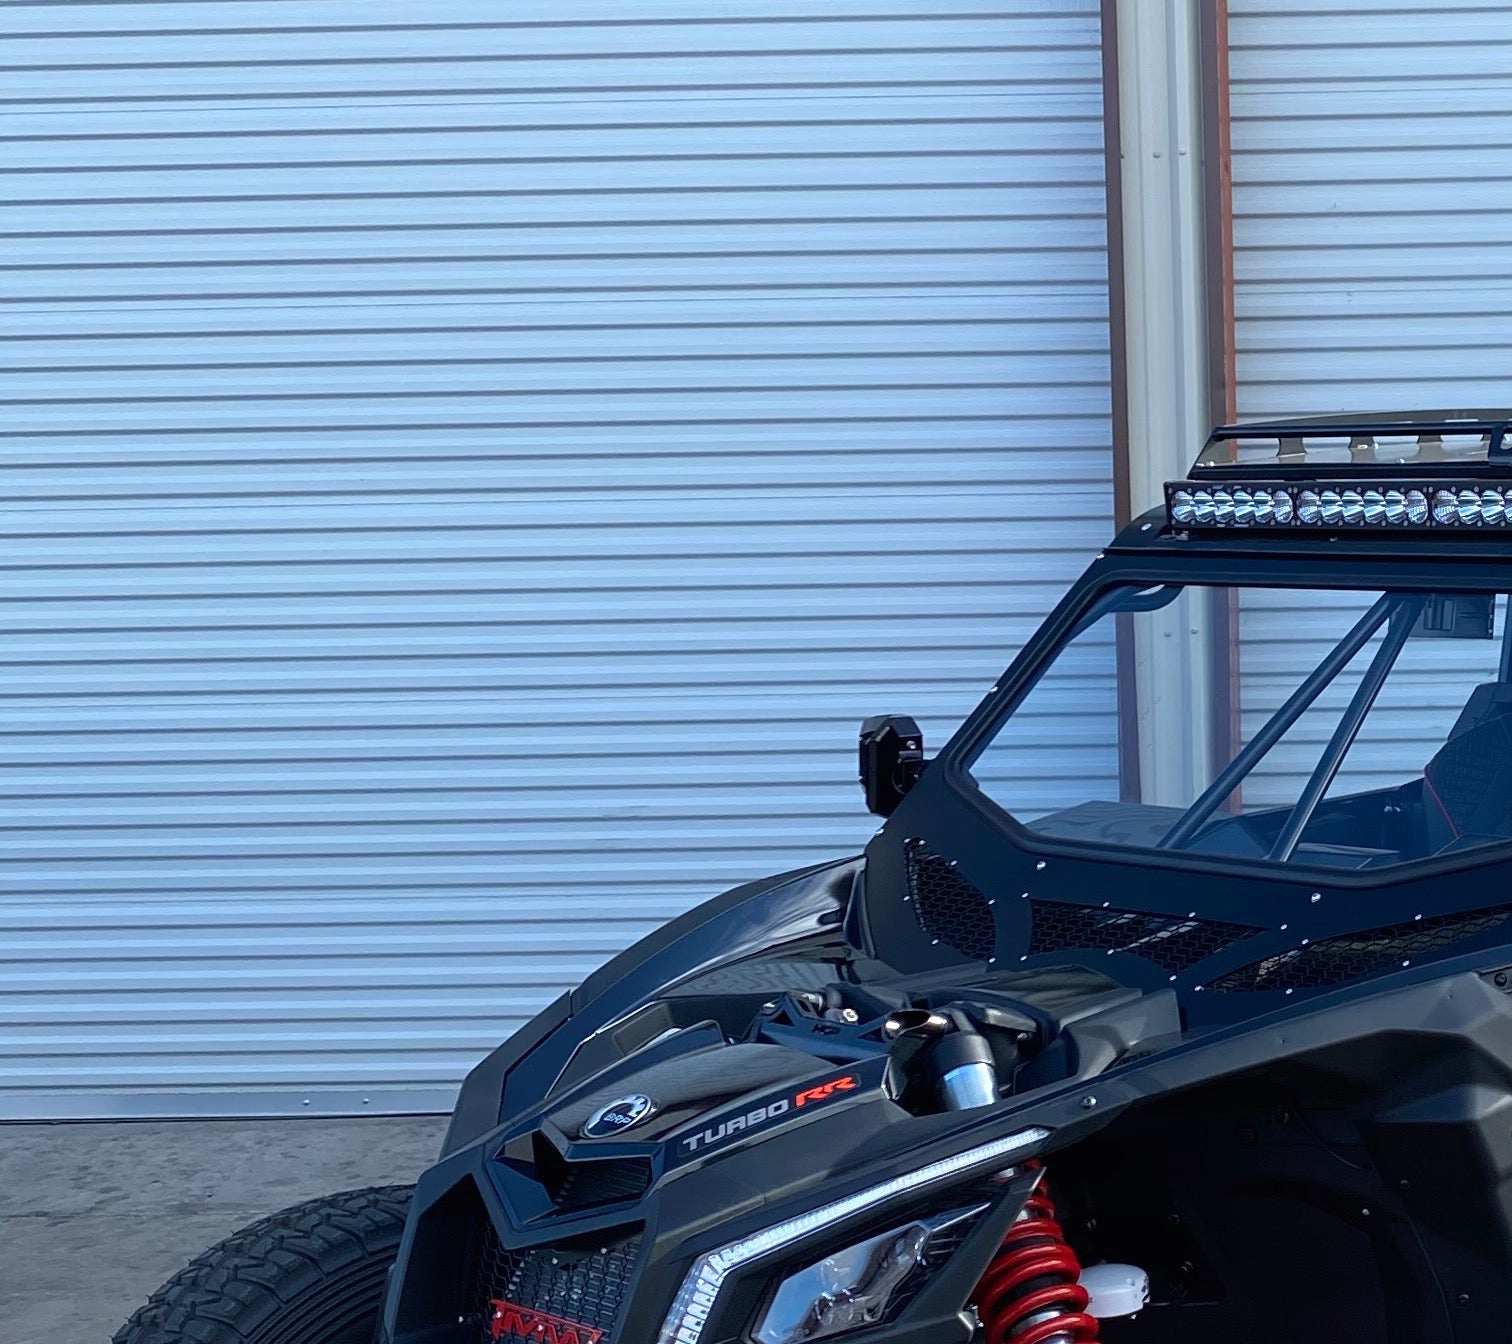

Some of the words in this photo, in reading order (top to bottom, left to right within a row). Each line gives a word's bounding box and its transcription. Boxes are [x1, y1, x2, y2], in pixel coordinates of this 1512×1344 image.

[603, 1112, 632, 1125] BRP
[682, 1099, 789, 1152] TURBO
[794, 1075, 858, 1109] RR
